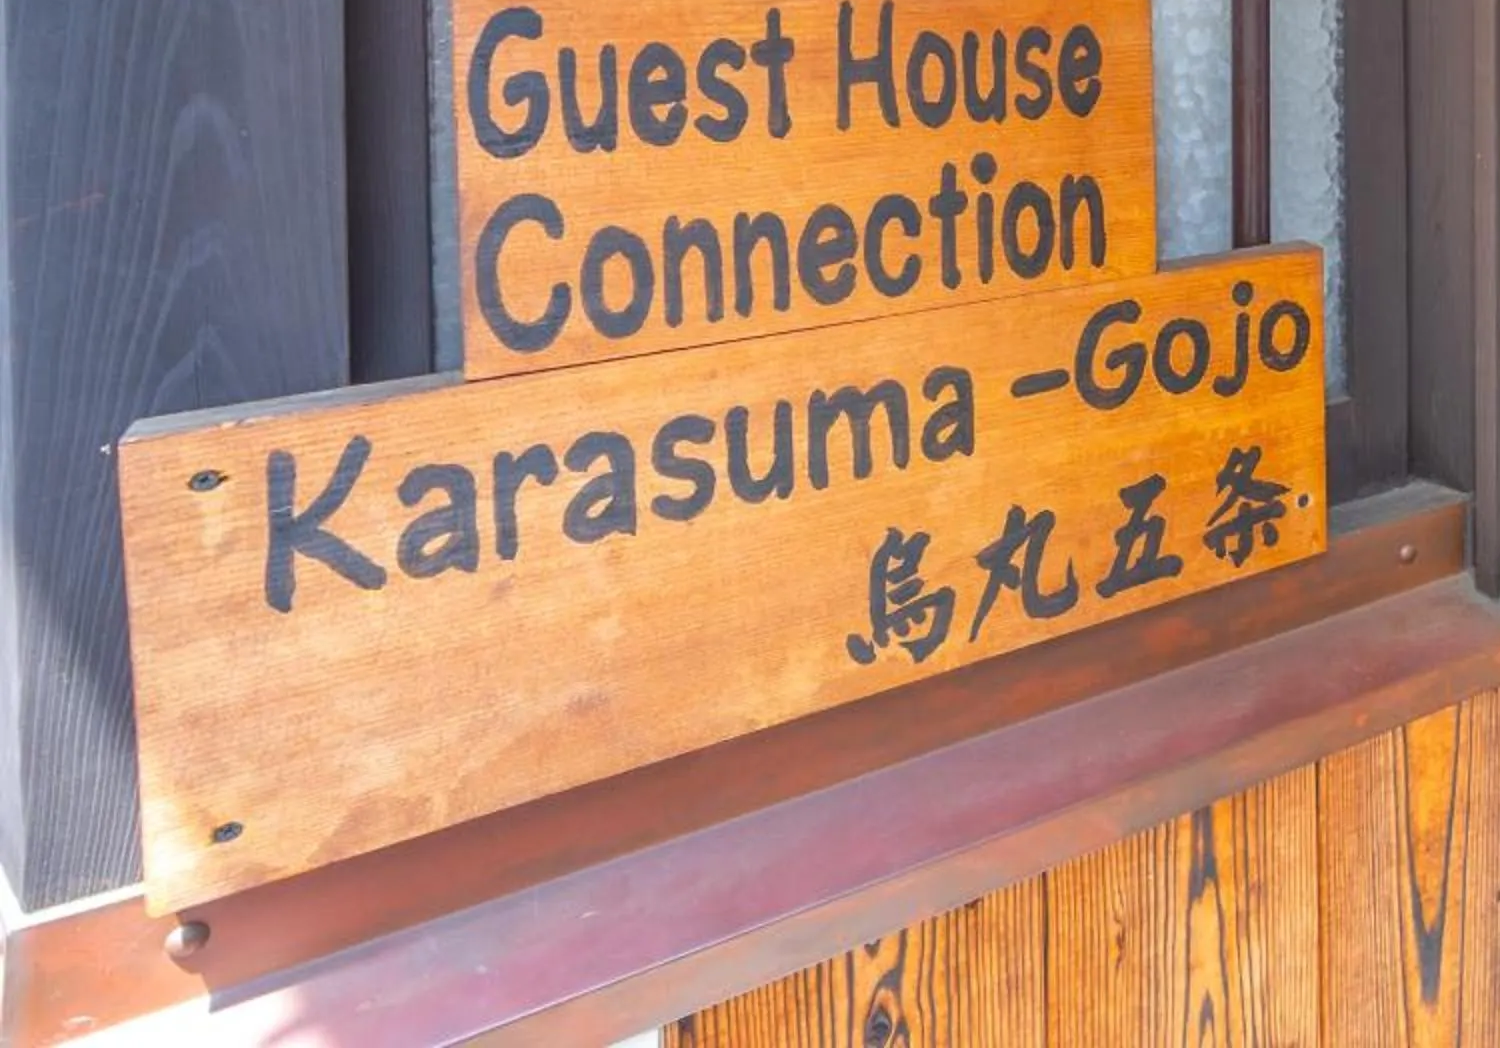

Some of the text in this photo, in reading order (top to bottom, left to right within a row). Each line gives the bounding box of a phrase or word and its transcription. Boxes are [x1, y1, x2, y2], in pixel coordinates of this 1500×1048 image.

[467, 0, 1103, 159] Guest House
[475, 152, 1108, 352] Connection
[263, 366, 975, 613] Karasuma
